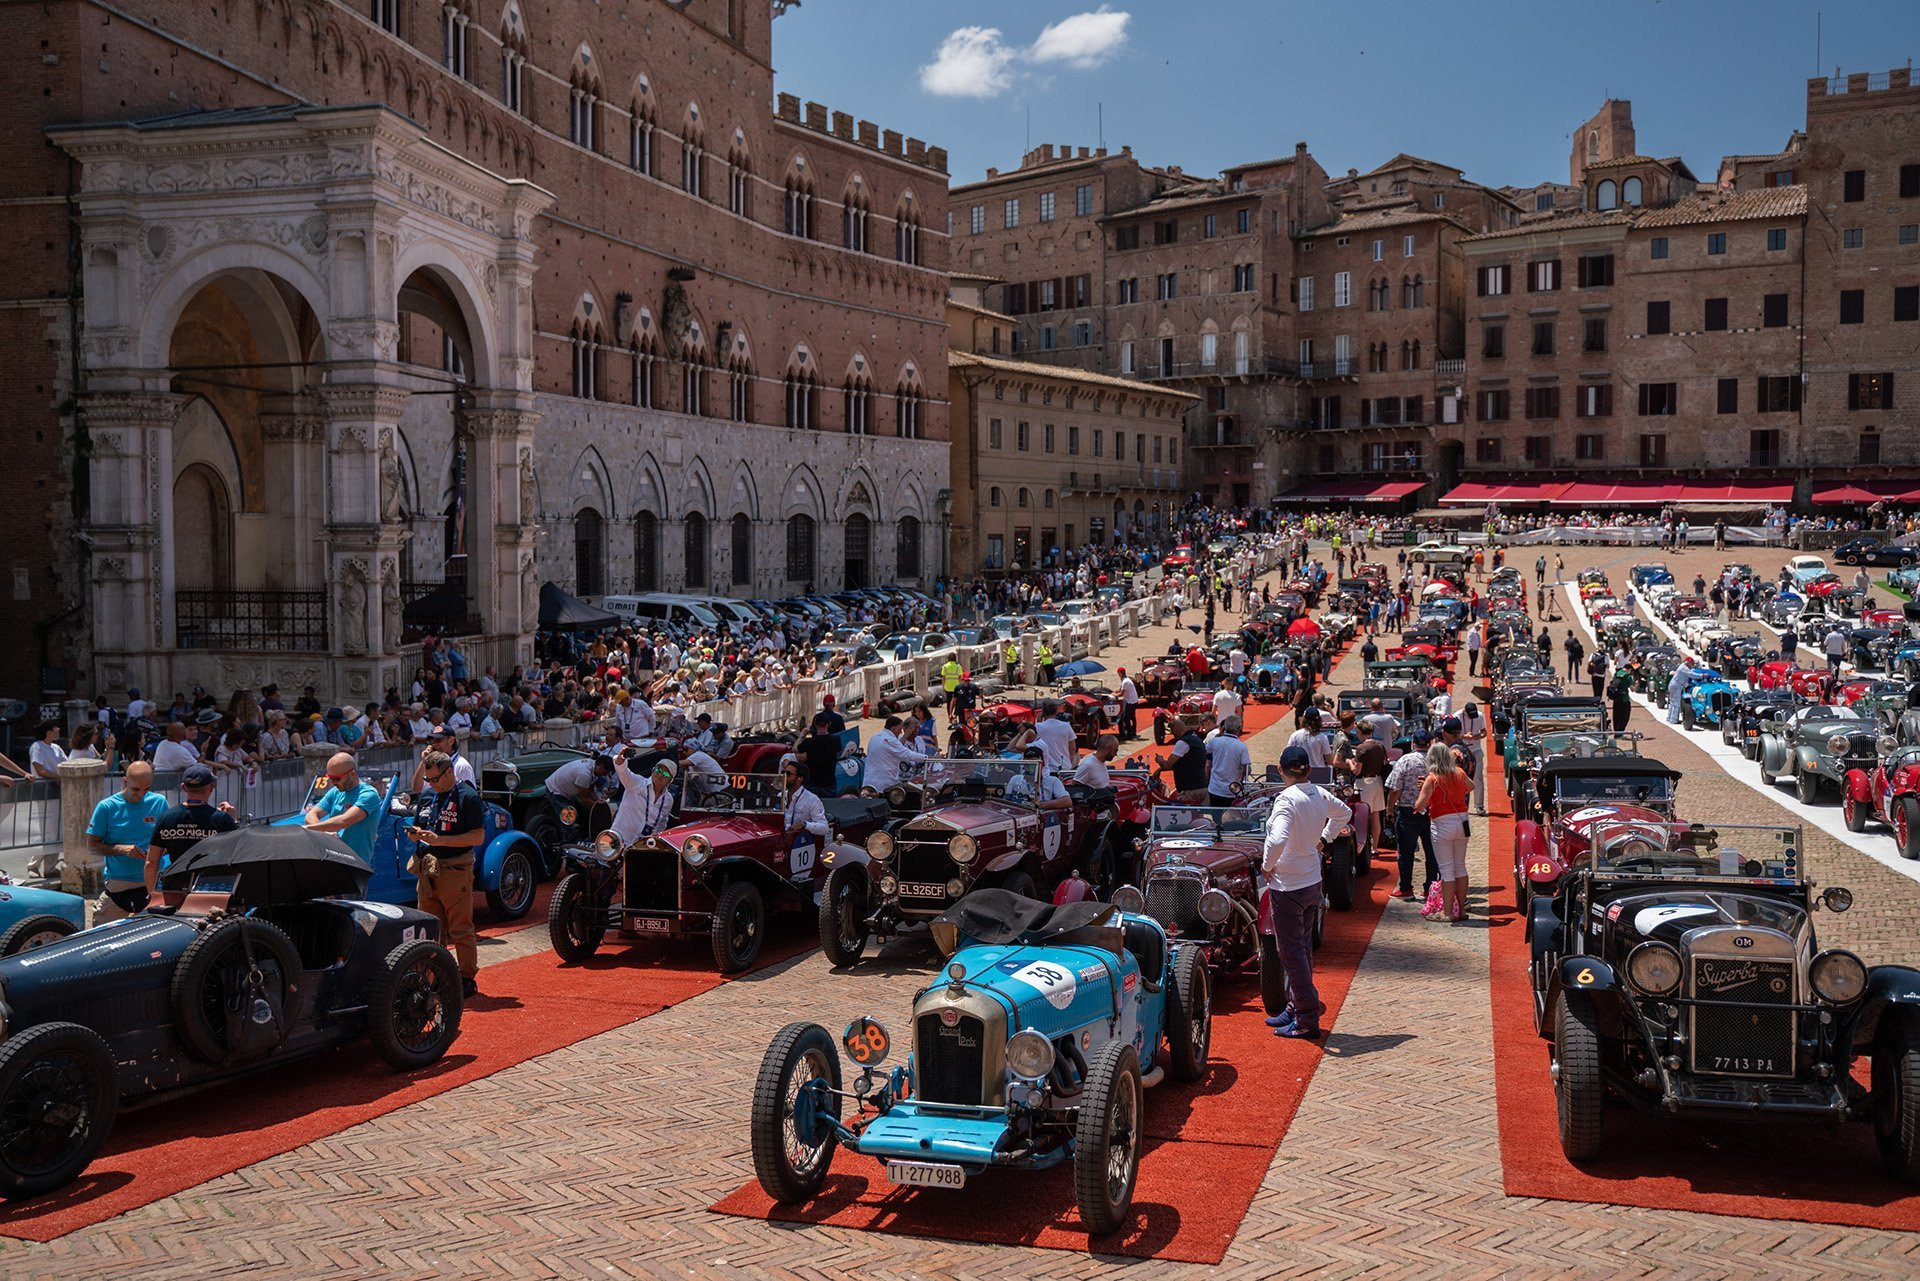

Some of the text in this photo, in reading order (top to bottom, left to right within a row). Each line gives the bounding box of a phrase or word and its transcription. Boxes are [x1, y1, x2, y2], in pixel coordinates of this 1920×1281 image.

[1806, 761, 1818, 769] 91
[315, 777, 328, 789] 13
[731, 775, 746, 789] 10
[562, 808, 576, 821] 23
[1169, 814, 1178, 825] 3
[160, 829, 218, 837] 1000 MIGLIA
[1050, 830, 1056, 847] 2
[797, 851, 809, 867] 10
[823, 851, 836, 864] 2
[1529, 863, 1551, 873] 48
[900, 885, 944, 896] EL926CF
[1735, 937, 1752, 946] OM
[1026, 966, 1063, 987] 38
[1576, 967, 1595, 984] 6
[1697, 961, 1758, 989] Superba
[939, 1026, 961, 1035] Grand
[848, 1025, 886, 1062] 38
[1715, 1057, 1773, 1071] 7713 PA
